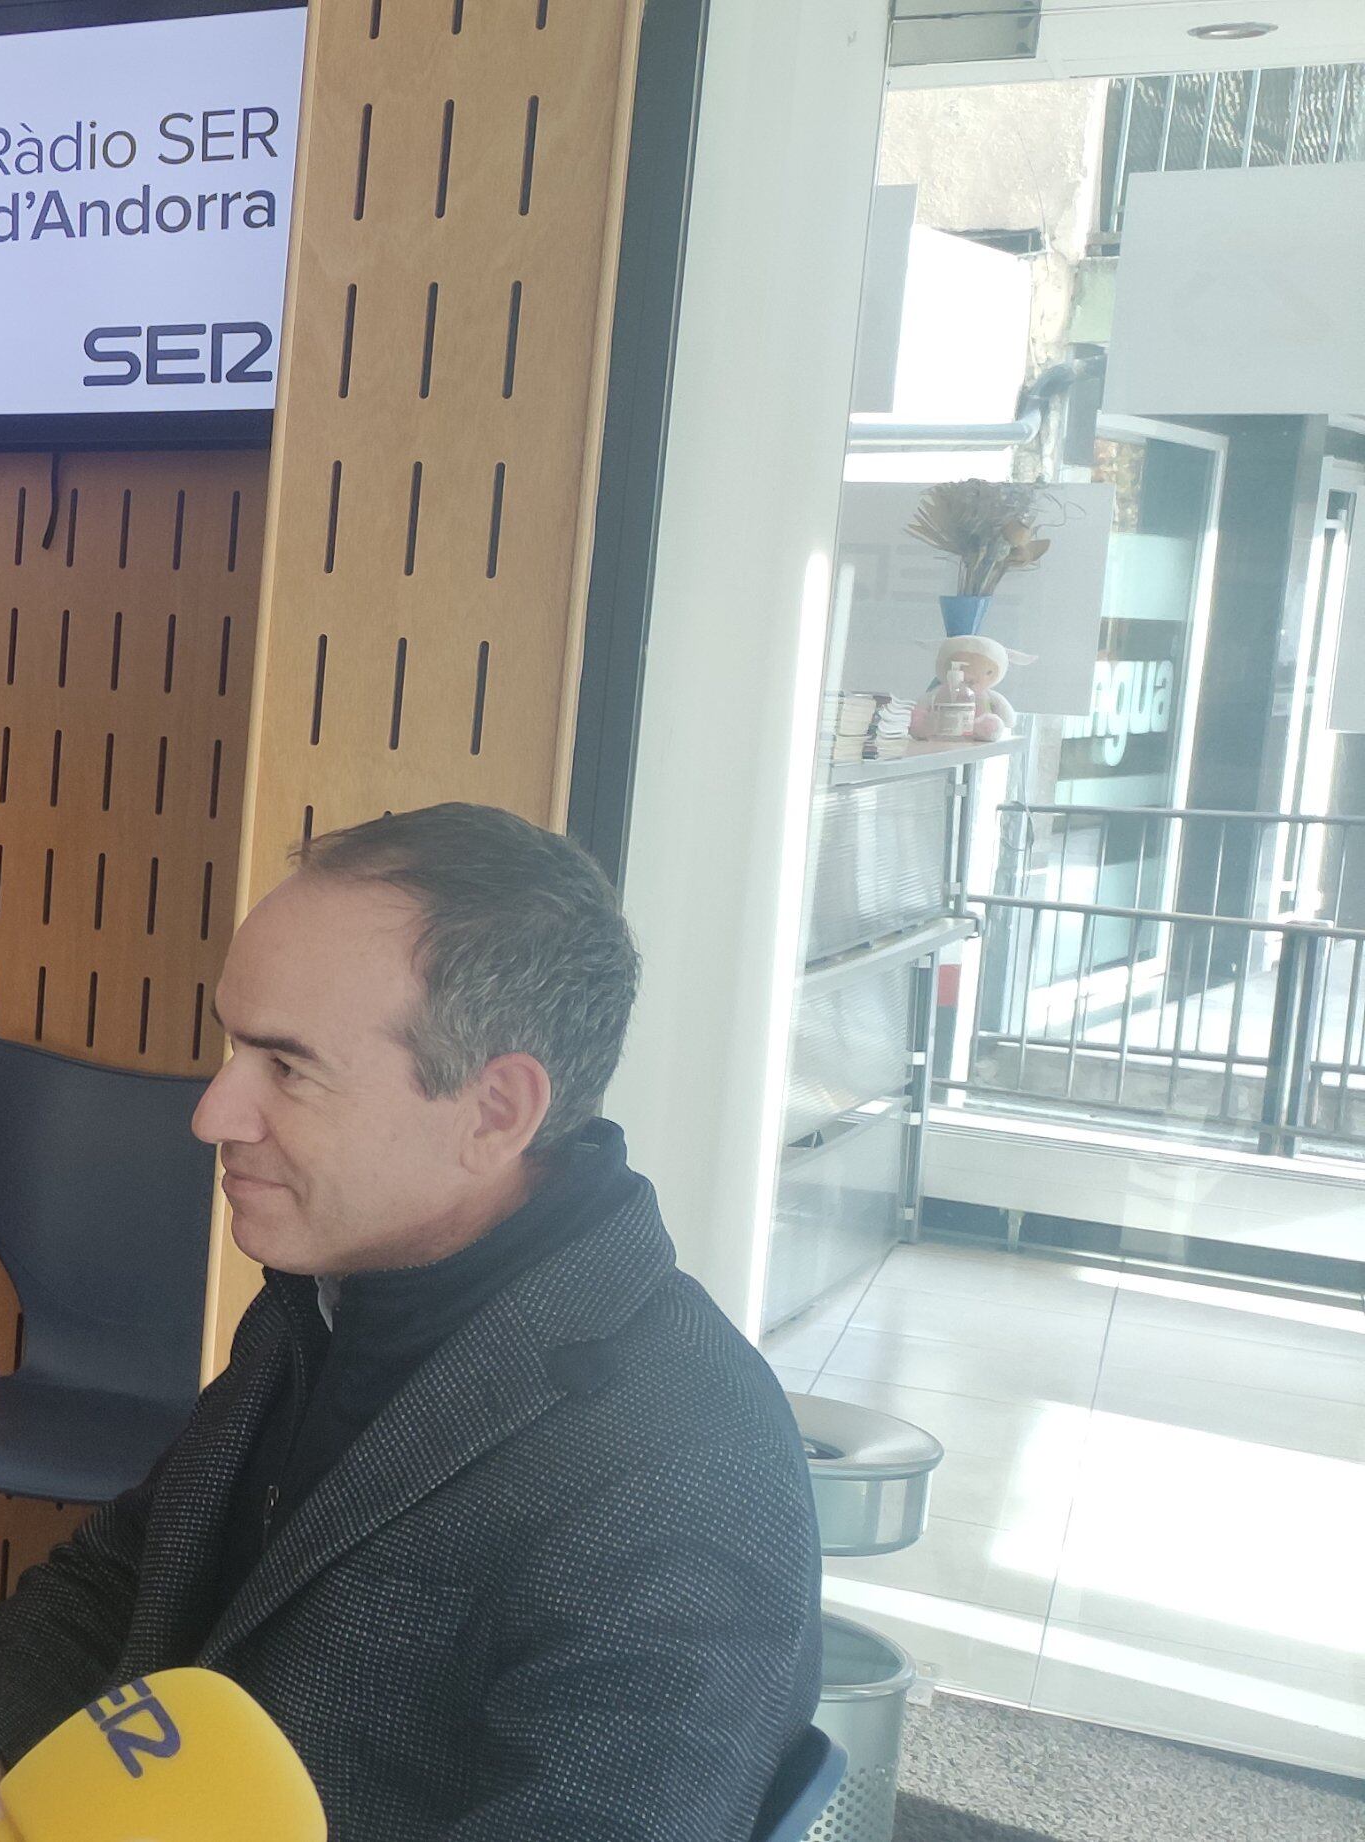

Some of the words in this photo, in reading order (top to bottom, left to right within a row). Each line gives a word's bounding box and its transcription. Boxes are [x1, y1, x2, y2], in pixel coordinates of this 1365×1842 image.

[158, 106, 280, 165] SER
[83, 321, 273, 387] SER
[83, 1677, 181, 1780] ER
